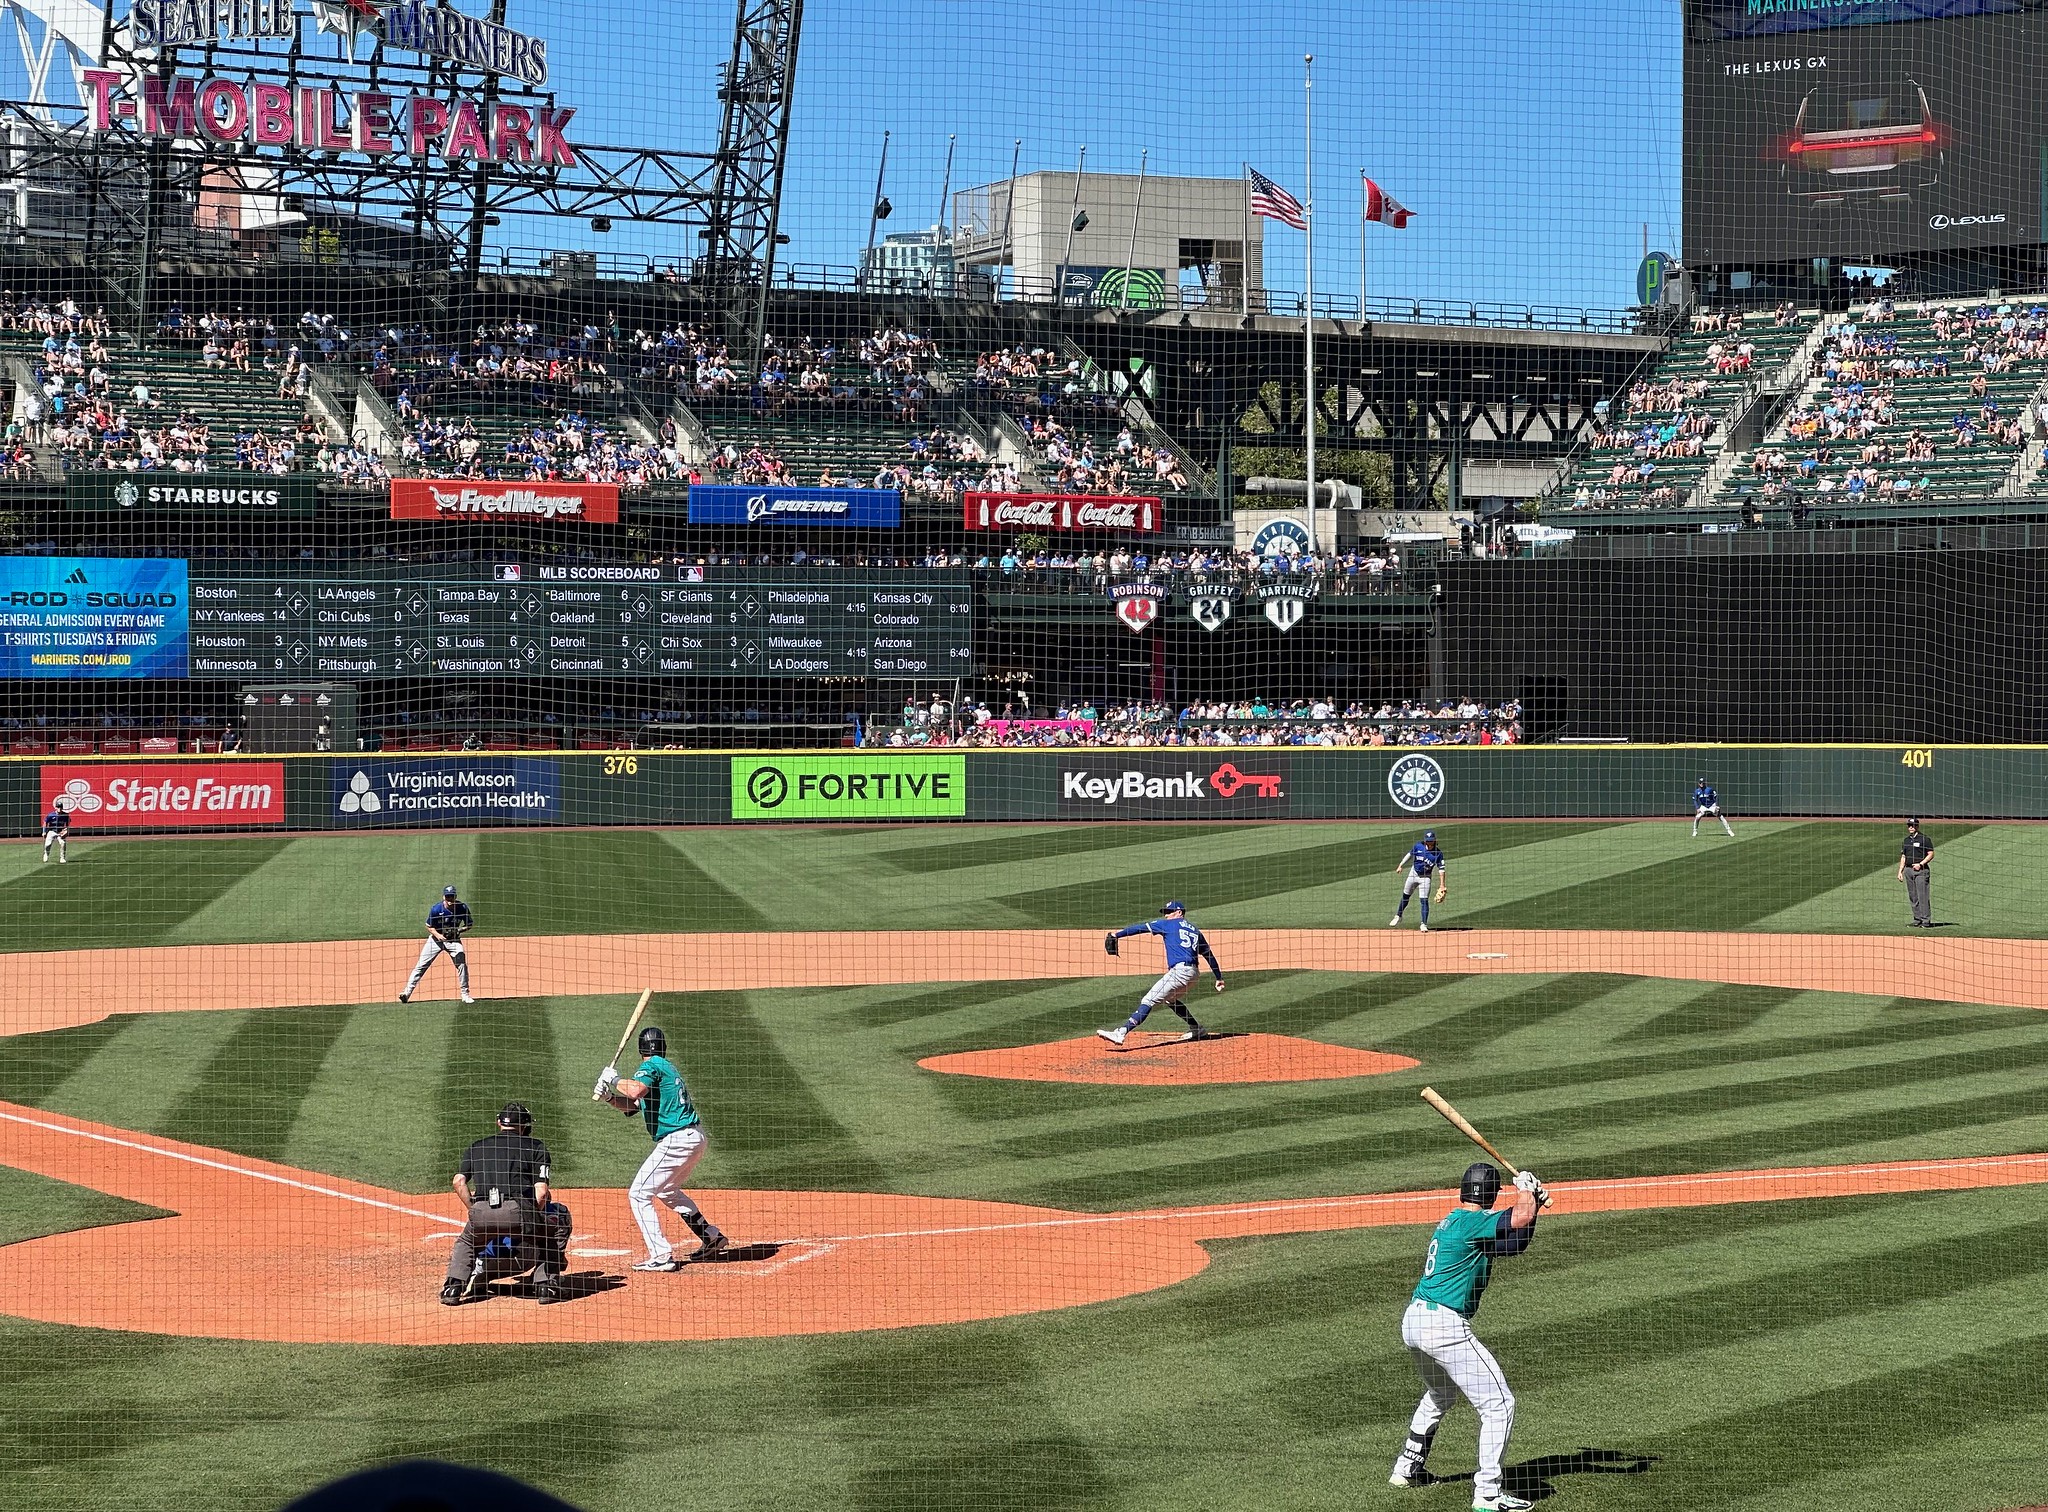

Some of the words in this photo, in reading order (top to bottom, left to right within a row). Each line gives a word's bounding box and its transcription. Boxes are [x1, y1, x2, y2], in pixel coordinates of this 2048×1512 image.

[130, 0, 296, 47] SEATTLE
[384, 0, 548, 86] MARINERS
[1724, 63, 1750, 76] THE
[1755, 58, 1802, 74] LEXUS
[1807, 56, 1827, 69] GX
[80, 67, 393, 153] T-MOBILE
[405, 95, 578, 168] PARK
[1950, 213, 2006, 226] LEXUS
[148, 486, 278, 505] STARBUCKS
[770, 498, 849, 513] BOEING
[994, 500, 1057, 526] Coca-Cola
[1077, 502, 1138, 528] Coca-Cola
[1255, 523, 1309, 549] SEATTLE
[539, 567, 567, 579] MLB
[570, 567, 660, 580] SCOREBOARD
[195, 586, 237, 599] Boston
[274, 586, 283, 598] 4
[318, 587, 335, 600] LA
[336, 588, 376, 603] Angels
[394, 588, 402, 599] 7
[436, 589, 475, 603] Tampa
[478, 589, 500, 604] Bay
[510, 588, 517, 600] 3
[550, 590, 600, 601] Baltimore
[621, 589, 629, 601] 6
[660, 590, 675, 602] SF
[678, 590, 713, 602] Giants
[729, 590, 737, 601] 4
[1112, 584, 1164, 598] ROBINSON
[1189, 585, 1235, 597] GRIFFEY
[1258, 585, 1314, 598] MARTINEZ
[86, 592, 177, 608] SQUAD
[768, 591, 829, 605] Philadelphia
[873, 592, 911, 604] Kansas
[913, 592, 933, 606] City
[294, 600, 302, 610] F
[413, 600, 420, 611] F
[528, 602, 535, 612] F
[638, 602, 645, 612] 9
[747, 603, 754, 612] F
[846, 602, 866, 613] 4:15
[950, 603, 969, 613] 6:10
[1124, 599, 1152, 622] 42
[1199, 599, 1225, 623] 24
[1276, 600, 1295, 623] 11
[44, 614, 102, 628] ADMISSION
[104, 614, 135, 628] EVERY
[136, 614, 165, 628] GAME
[195, 609, 214, 621] NY
[216, 610, 265, 622] Yankees
[272, 610, 286, 621] 14
[318, 610, 338, 622] Chi
[340, 610, 371, 622] Cubs
[394, 610, 402, 622] 0
[436, 611, 470, 623] Texas
[509, 611, 518, 622] 4
[550, 612, 595, 623] Oakland
[619, 611, 632, 623] 19
[660, 612, 712, 624] Cleveland
[730, 612, 737, 623] 5
[768, 613, 805, 624] Atlanta
[873, 613, 919, 625] Colorado
[4, 632, 51, 646] T-SHIRTS
[53, 632, 104, 646] TUESDAYS
[106, 633, 114, 646] &
[116, 632, 157, 646] FRIDAYS
[196, 635, 245, 647] Houston
[274, 635, 283, 646] 3
[318, 635, 337, 647] NY
[339, 635, 368, 648] Mets
[394, 635, 402, 647] 5
[436, 636, 452, 648] St.
[455, 636, 485, 648] Louis
[510, 635, 518, 647] 6
[550, 636, 586, 648] Detroit
[621, 635, 629, 647] 5
[661, 636, 679, 648] Chi
[682, 637, 703, 648] Sox
[730, 636, 737, 647] 3
[768, 636, 823, 648] Milwaukee
[874, 637, 912, 648] Arizona
[294, 648, 302, 658] F
[413, 648, 421, 658] F
[528, 648, 534, 658] 8
[639, 648, 646, 658] F
[748, 648, 754, 658] F
[846, 647, 867, 658] 4:15
[950, 648, 970, 658] 6:40
[31, 653, 131, 666] MARINERS.COM/JROD
[196, 658, 257, 670] Minnesota
[275, 658, 283, 670] 9
[318, 658, 377, 673] Pittsburgh
[395, 658, 402, 670] 2
[437, 658, 503, 673] Washington
[508, 658, 521, 669] 13
[550, 658, 603, 670] Cincinnati
[621, 657, 629, 669] 3
[660, 658, 692, 670] Miami
[730, 658, 737, 669] 4
[768, 658, 784, 670] LA
[785, 658, 829, 672] Dodgers
[874, 658, 894, 670] San
[897, 658, 927, 672] Diego
[1901, 749, 1933, 768] 401
[603, 756, 638, 775] 376
[1395, 759, 1438, 778] SEATTLE
[387, 771, 454, 792] Virginia
[457, 771, 516, 788] Mason
[798, 773, 950, 800] FORTIVE
[1063, 771, 1206, 804] KeyBank
[388, 793, 482, 809] Franciscan
[1394, 786, 1438, 807] MARINERS
